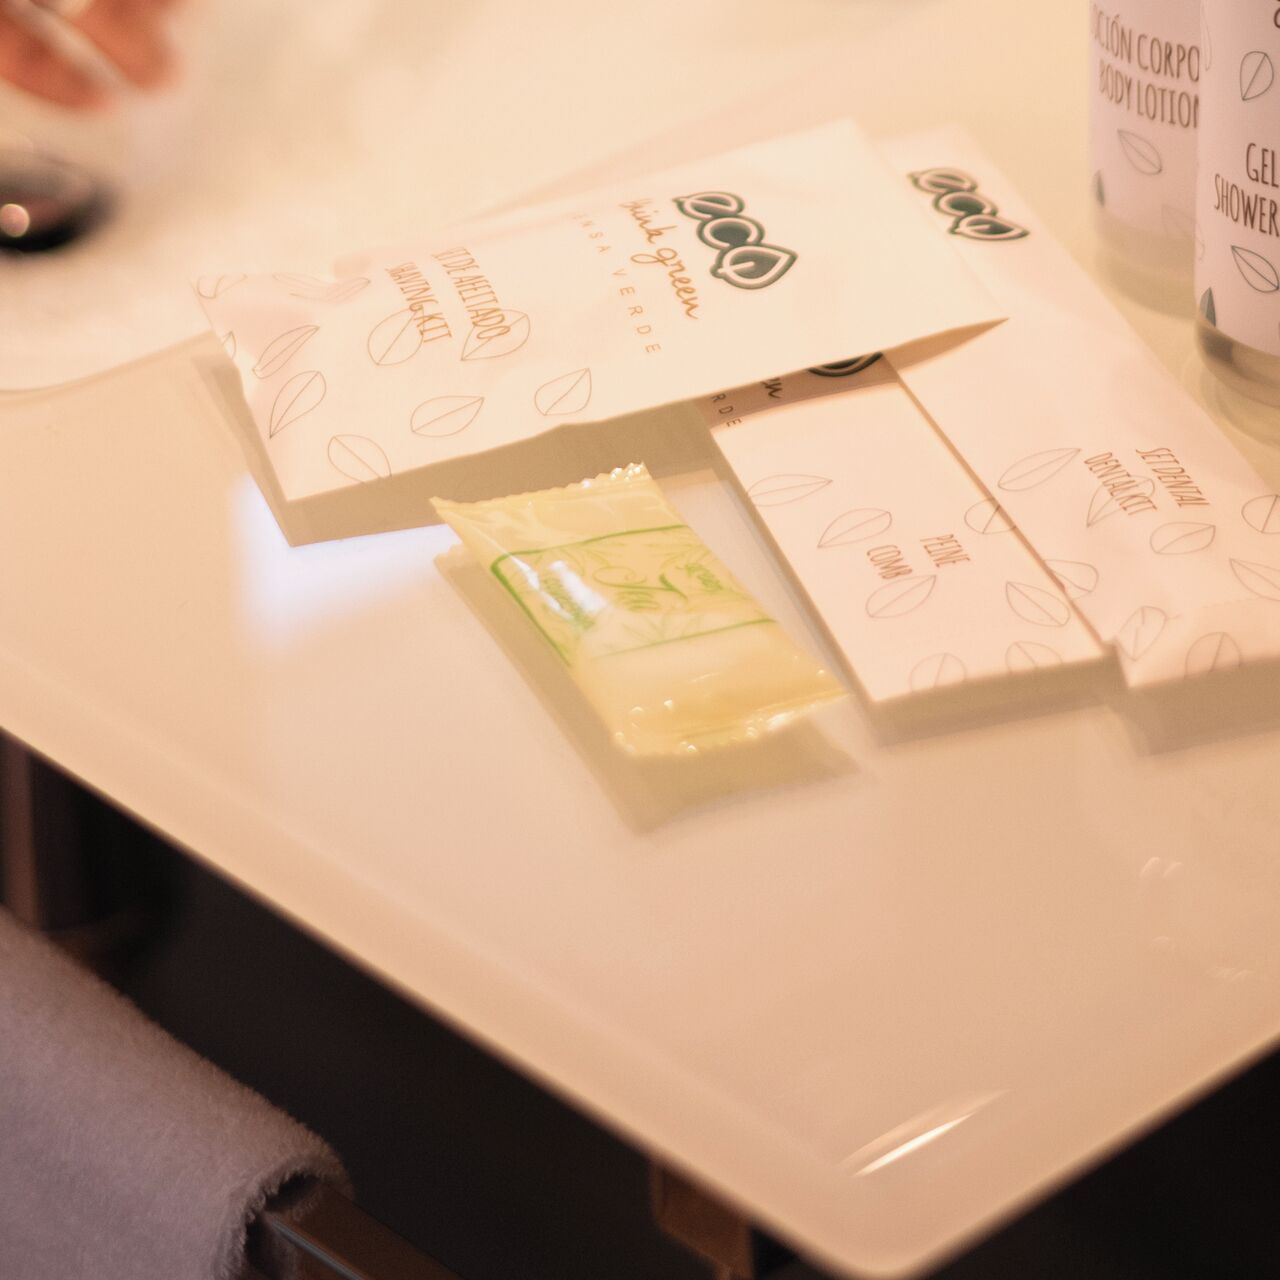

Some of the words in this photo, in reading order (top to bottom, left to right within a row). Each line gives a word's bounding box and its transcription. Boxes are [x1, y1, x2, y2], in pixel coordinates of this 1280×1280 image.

[1093, 4, 1132, 64] CIÓN
[1137, 33, 1200, 82] CORPO
[1100, 59, 1132, 111] BODY
[1246, 142, 1280, 188] GEL
[907, 167, 1030, 242] eco
[1214, 173, 1280, 237] SHOWER
[442, 258, 480, 275] DE
[672, 191, 798, 290] eco
[453, 275, 511, 340] AFEITADO
[612, 269, 661, 352] VERDE
[630, 247, 699, 319] green
[414, 312, 452, 343] KIT
[1084, 452, 1139, 497] DENTAL
[1115, 492, 1158, 516] KIT
[1136, 447, 1180, 464] SET
[1152, 466, 1210, 508] DENTAL
[866, 544, 913, 580] COMB
[920, 534, 970, 567] PEINE
